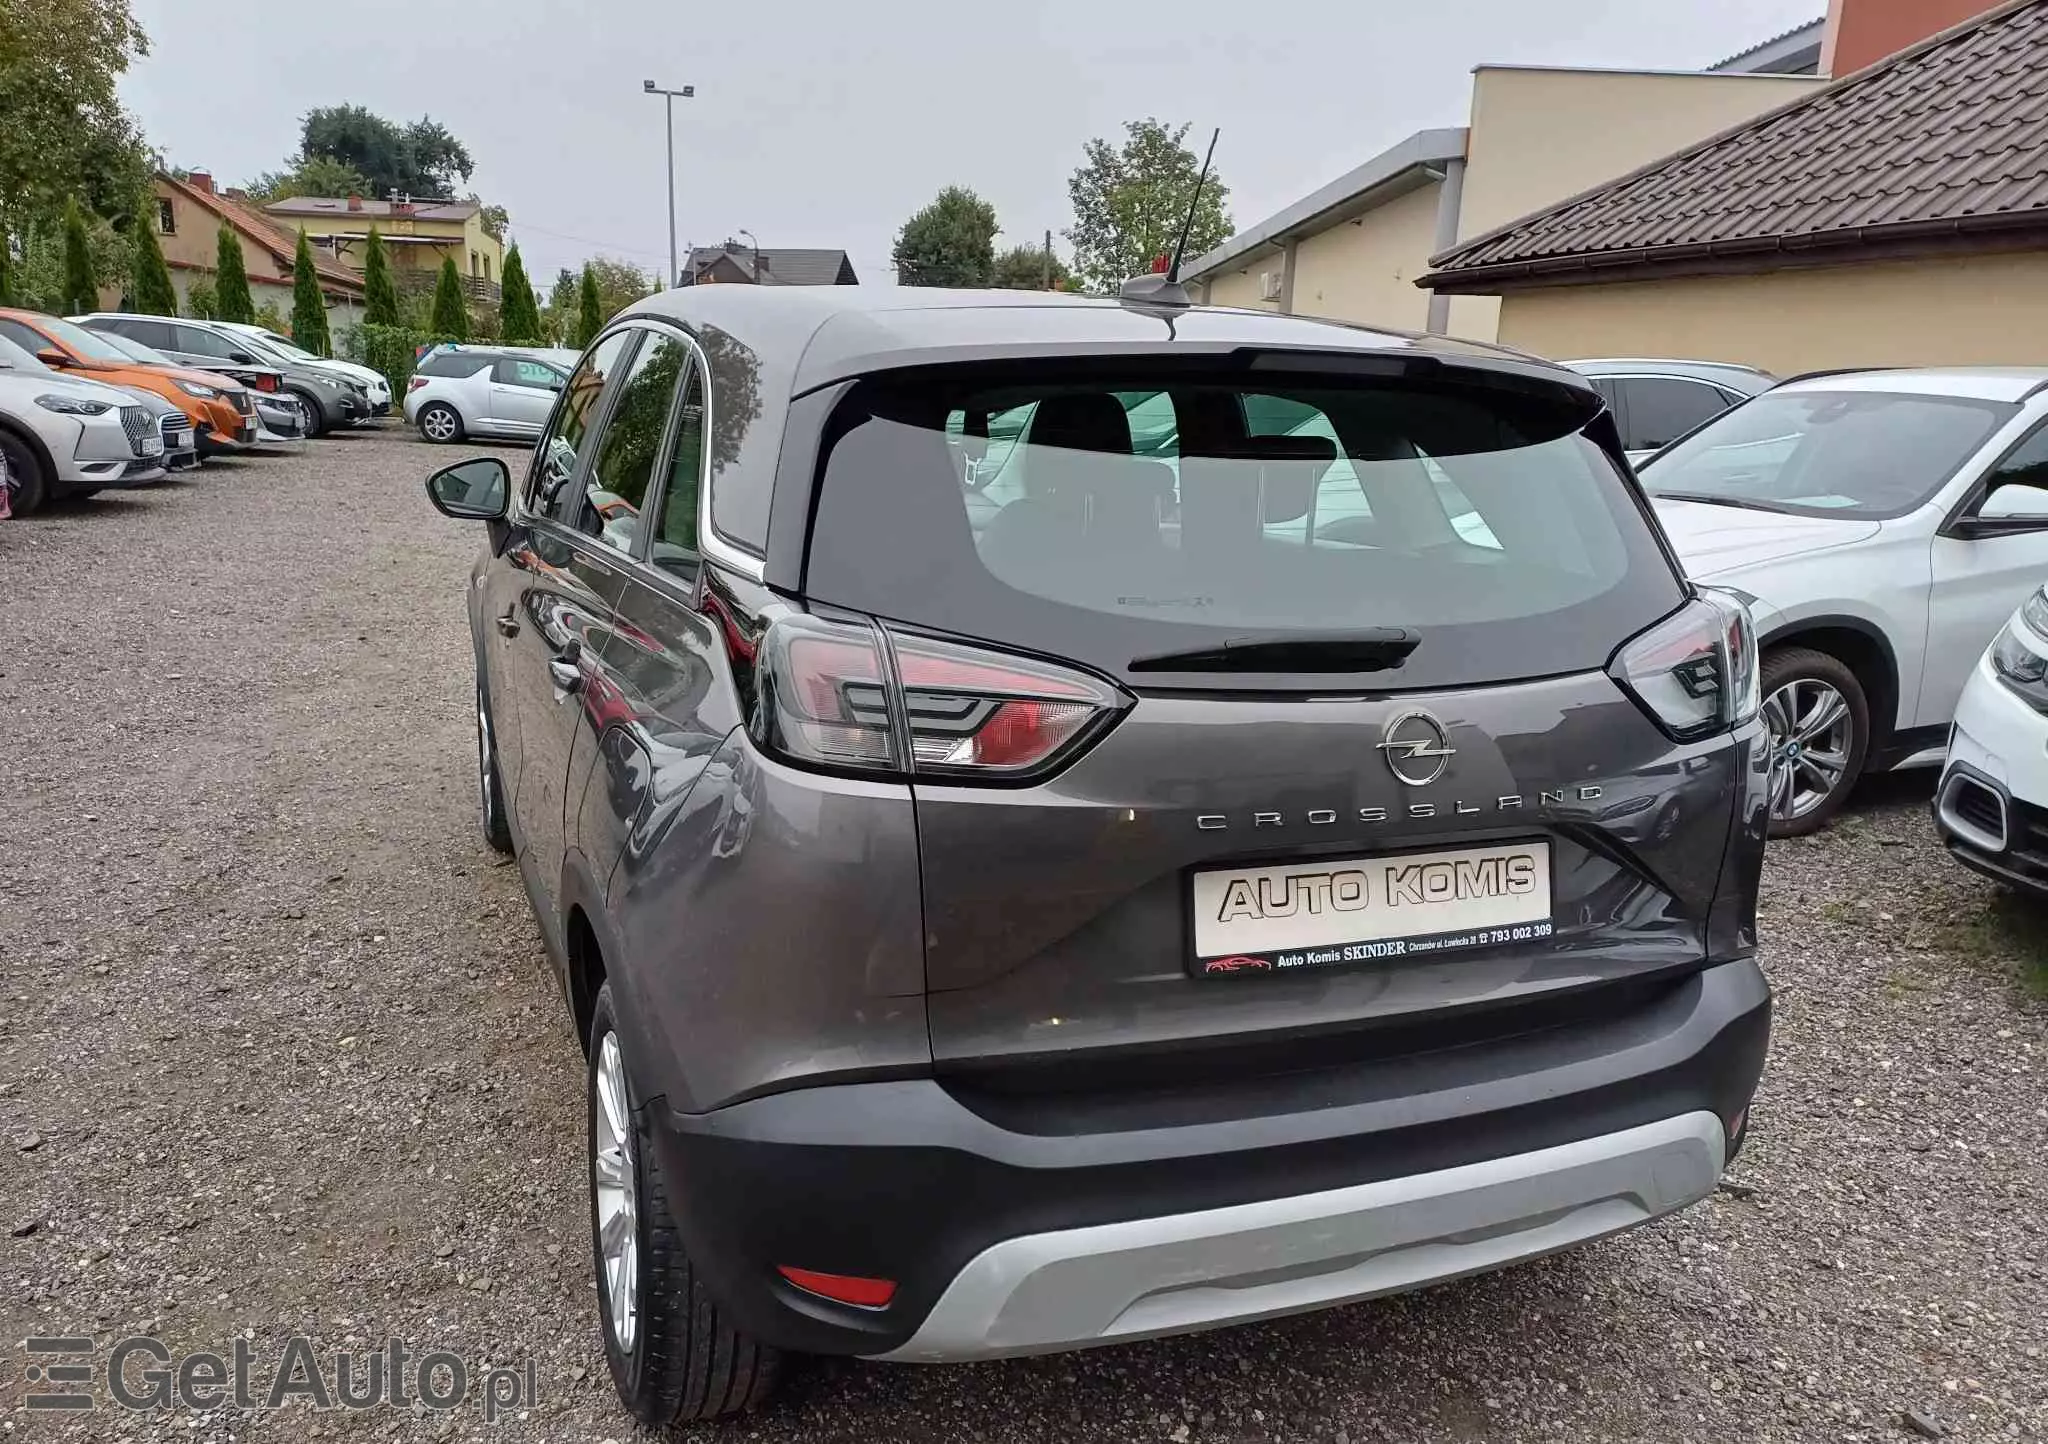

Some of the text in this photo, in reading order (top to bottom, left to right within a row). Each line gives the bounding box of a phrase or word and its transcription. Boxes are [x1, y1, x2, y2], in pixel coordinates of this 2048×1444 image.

[1196, 785, 1601, 830] CROSSLAND
[1218, 854, 1536, 922] AUTO KOMIS
[1277, 954, 1304, 968] Auto
[1306, 950, 1341, 965] Komis
[1343, 940, 1406, 961] SKINDER
[1490, 930, 1511, 942] 793
[1512, 926, 1532, 940] 002
[1533, 923, 1552, 937] 309
